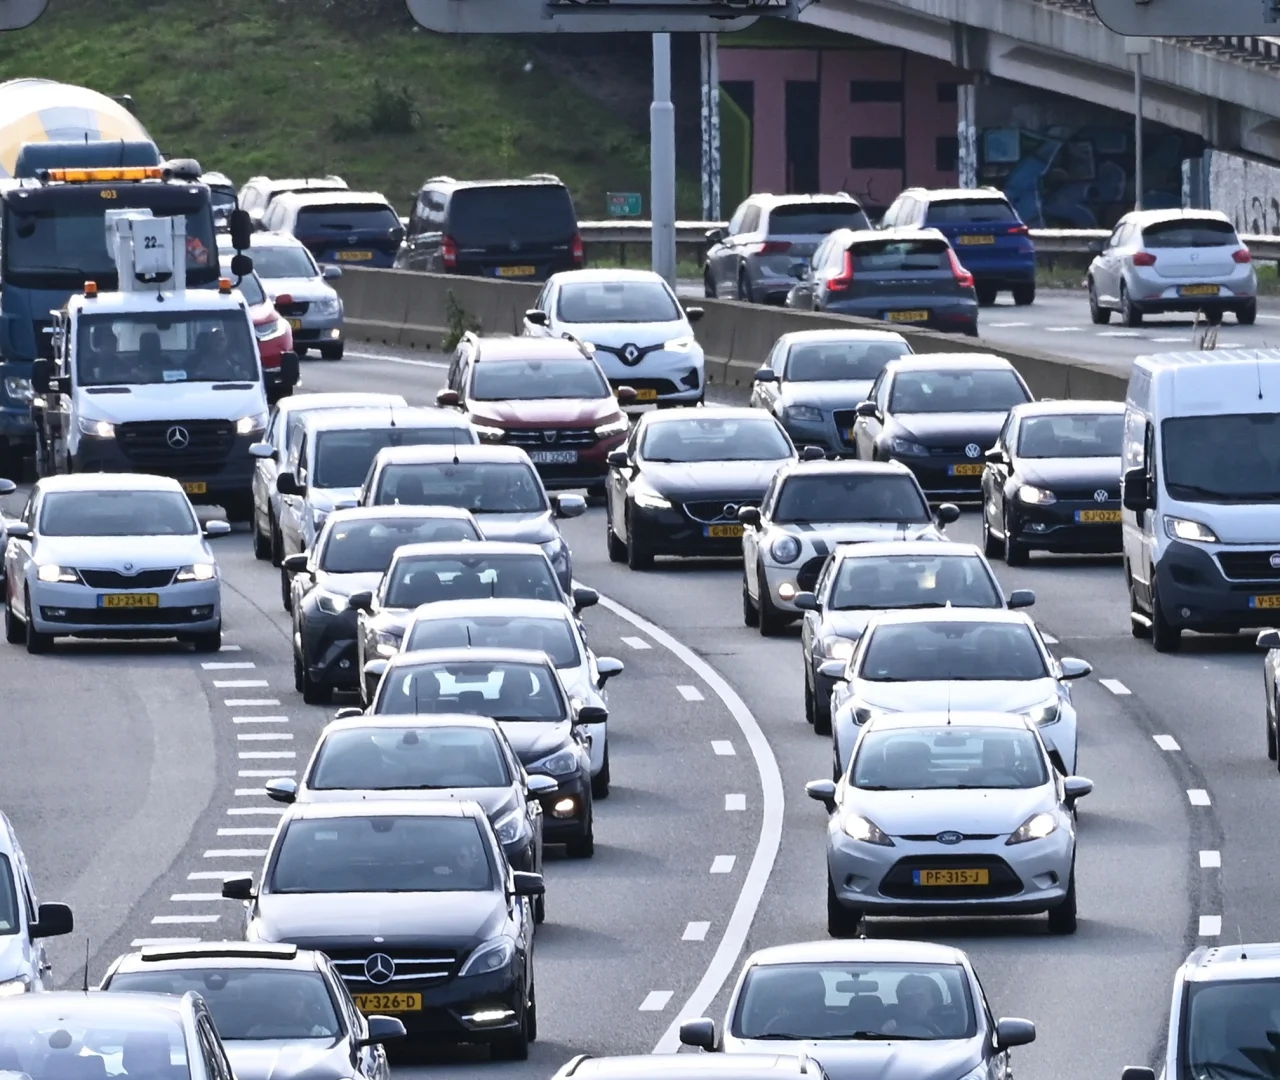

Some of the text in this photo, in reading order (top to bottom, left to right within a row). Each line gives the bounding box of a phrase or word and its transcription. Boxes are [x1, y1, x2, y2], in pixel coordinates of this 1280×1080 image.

[144, 236, 157, 249] 22
[1084, 511, 1120, 521] SJ-027-
[712, 526, 743, 536] G-810-
[108, 594, 152, 605] RJ-234-L
[926, 871, 979, 883] PF-315-J
